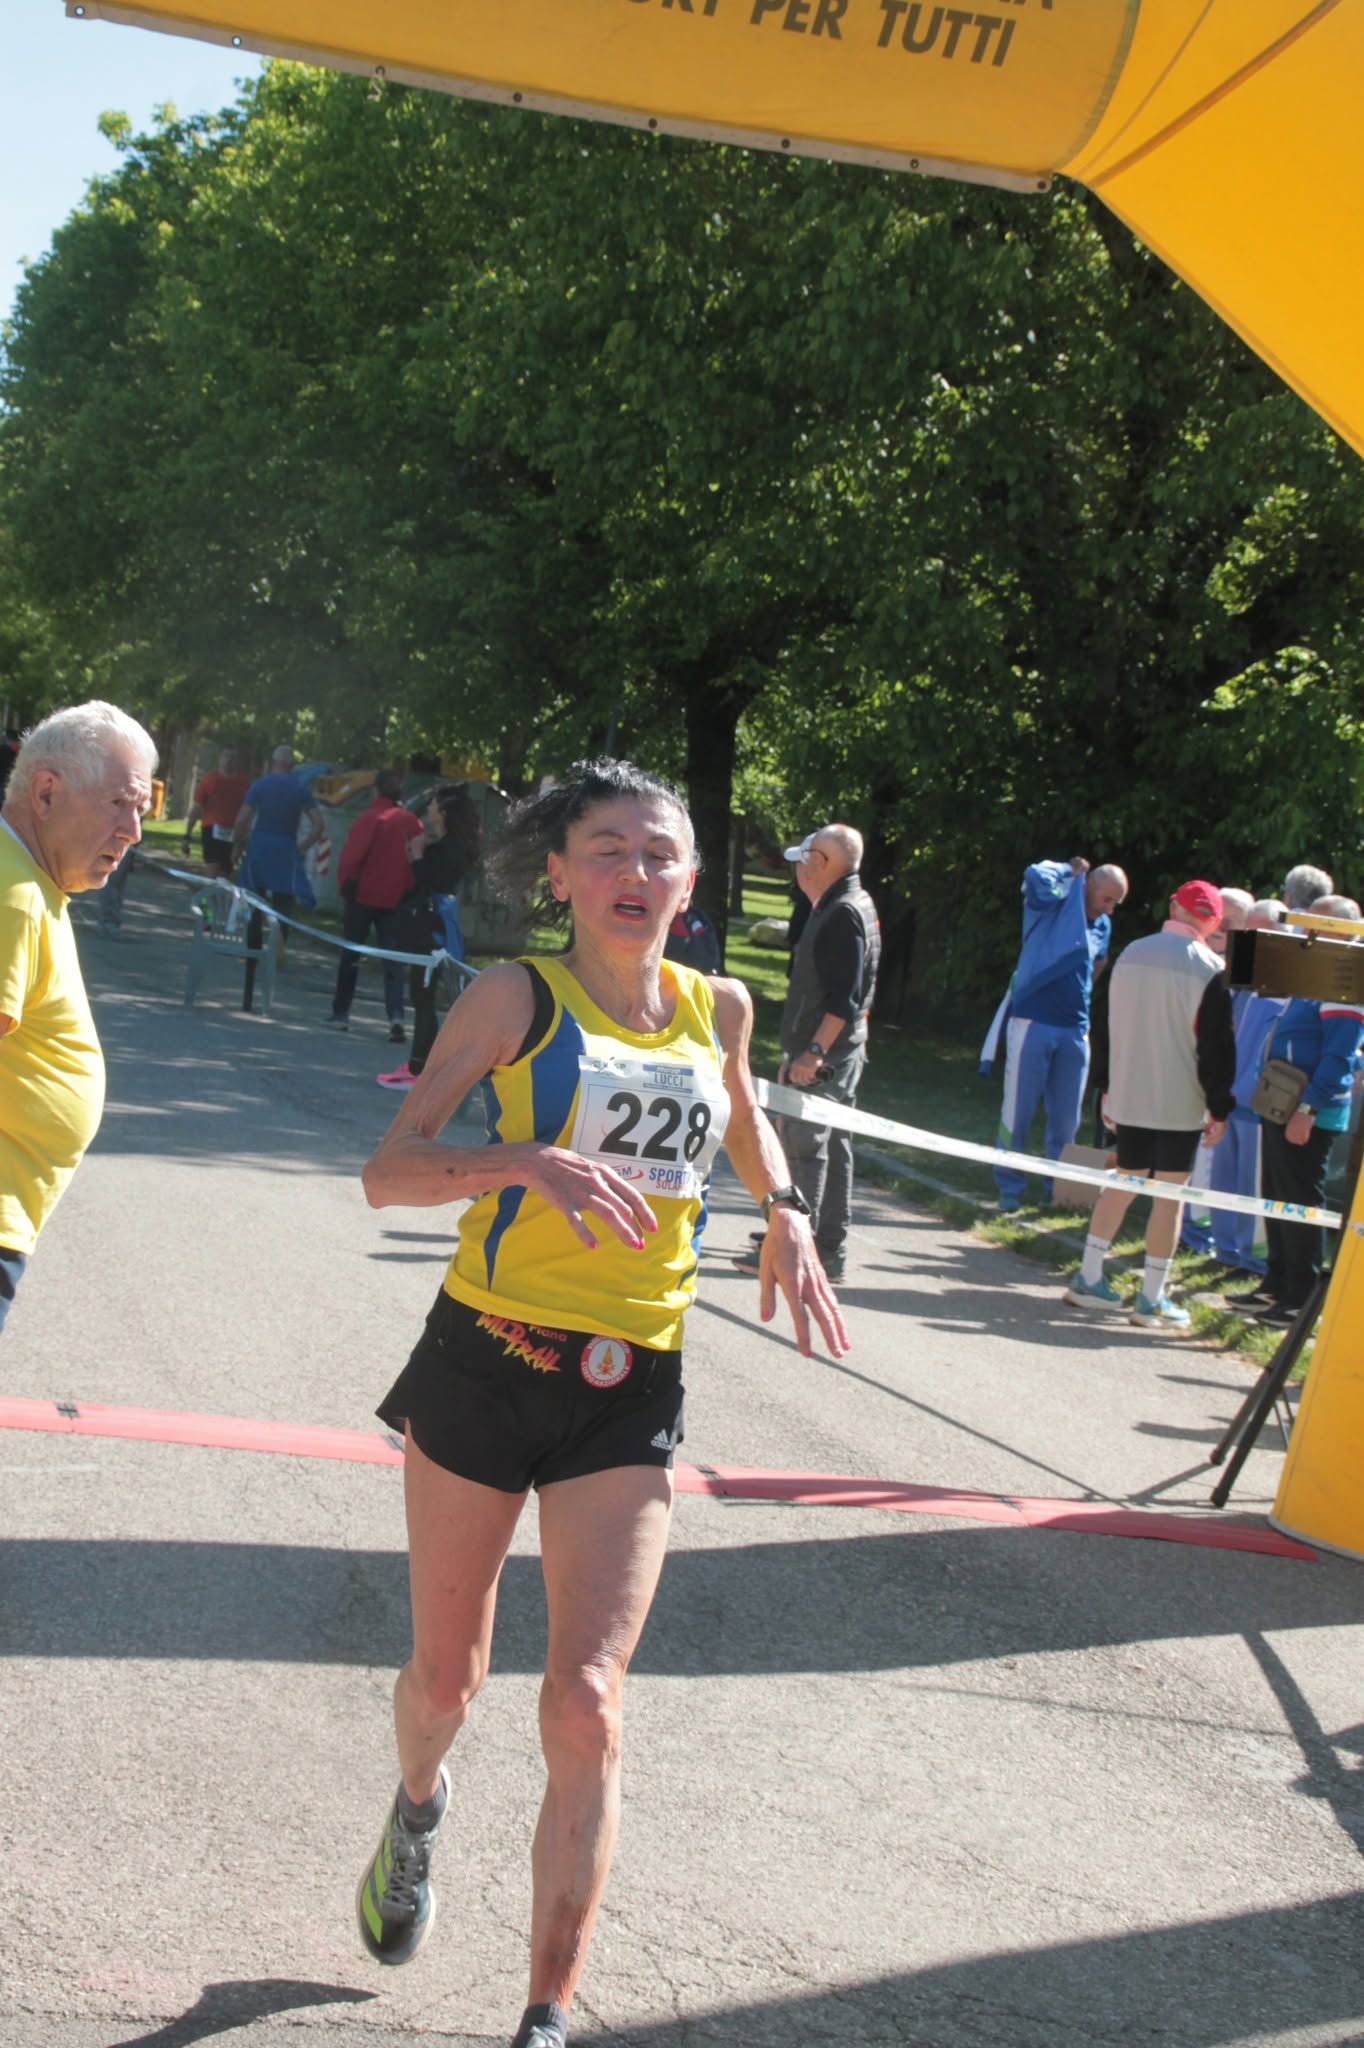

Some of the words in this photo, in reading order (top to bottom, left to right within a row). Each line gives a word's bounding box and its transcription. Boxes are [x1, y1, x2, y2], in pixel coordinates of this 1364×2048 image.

[749, 0, 849, 41] PER
[876, 0, 1017, 68] TUTTI
[598, 1091, 711, 1163] 228
